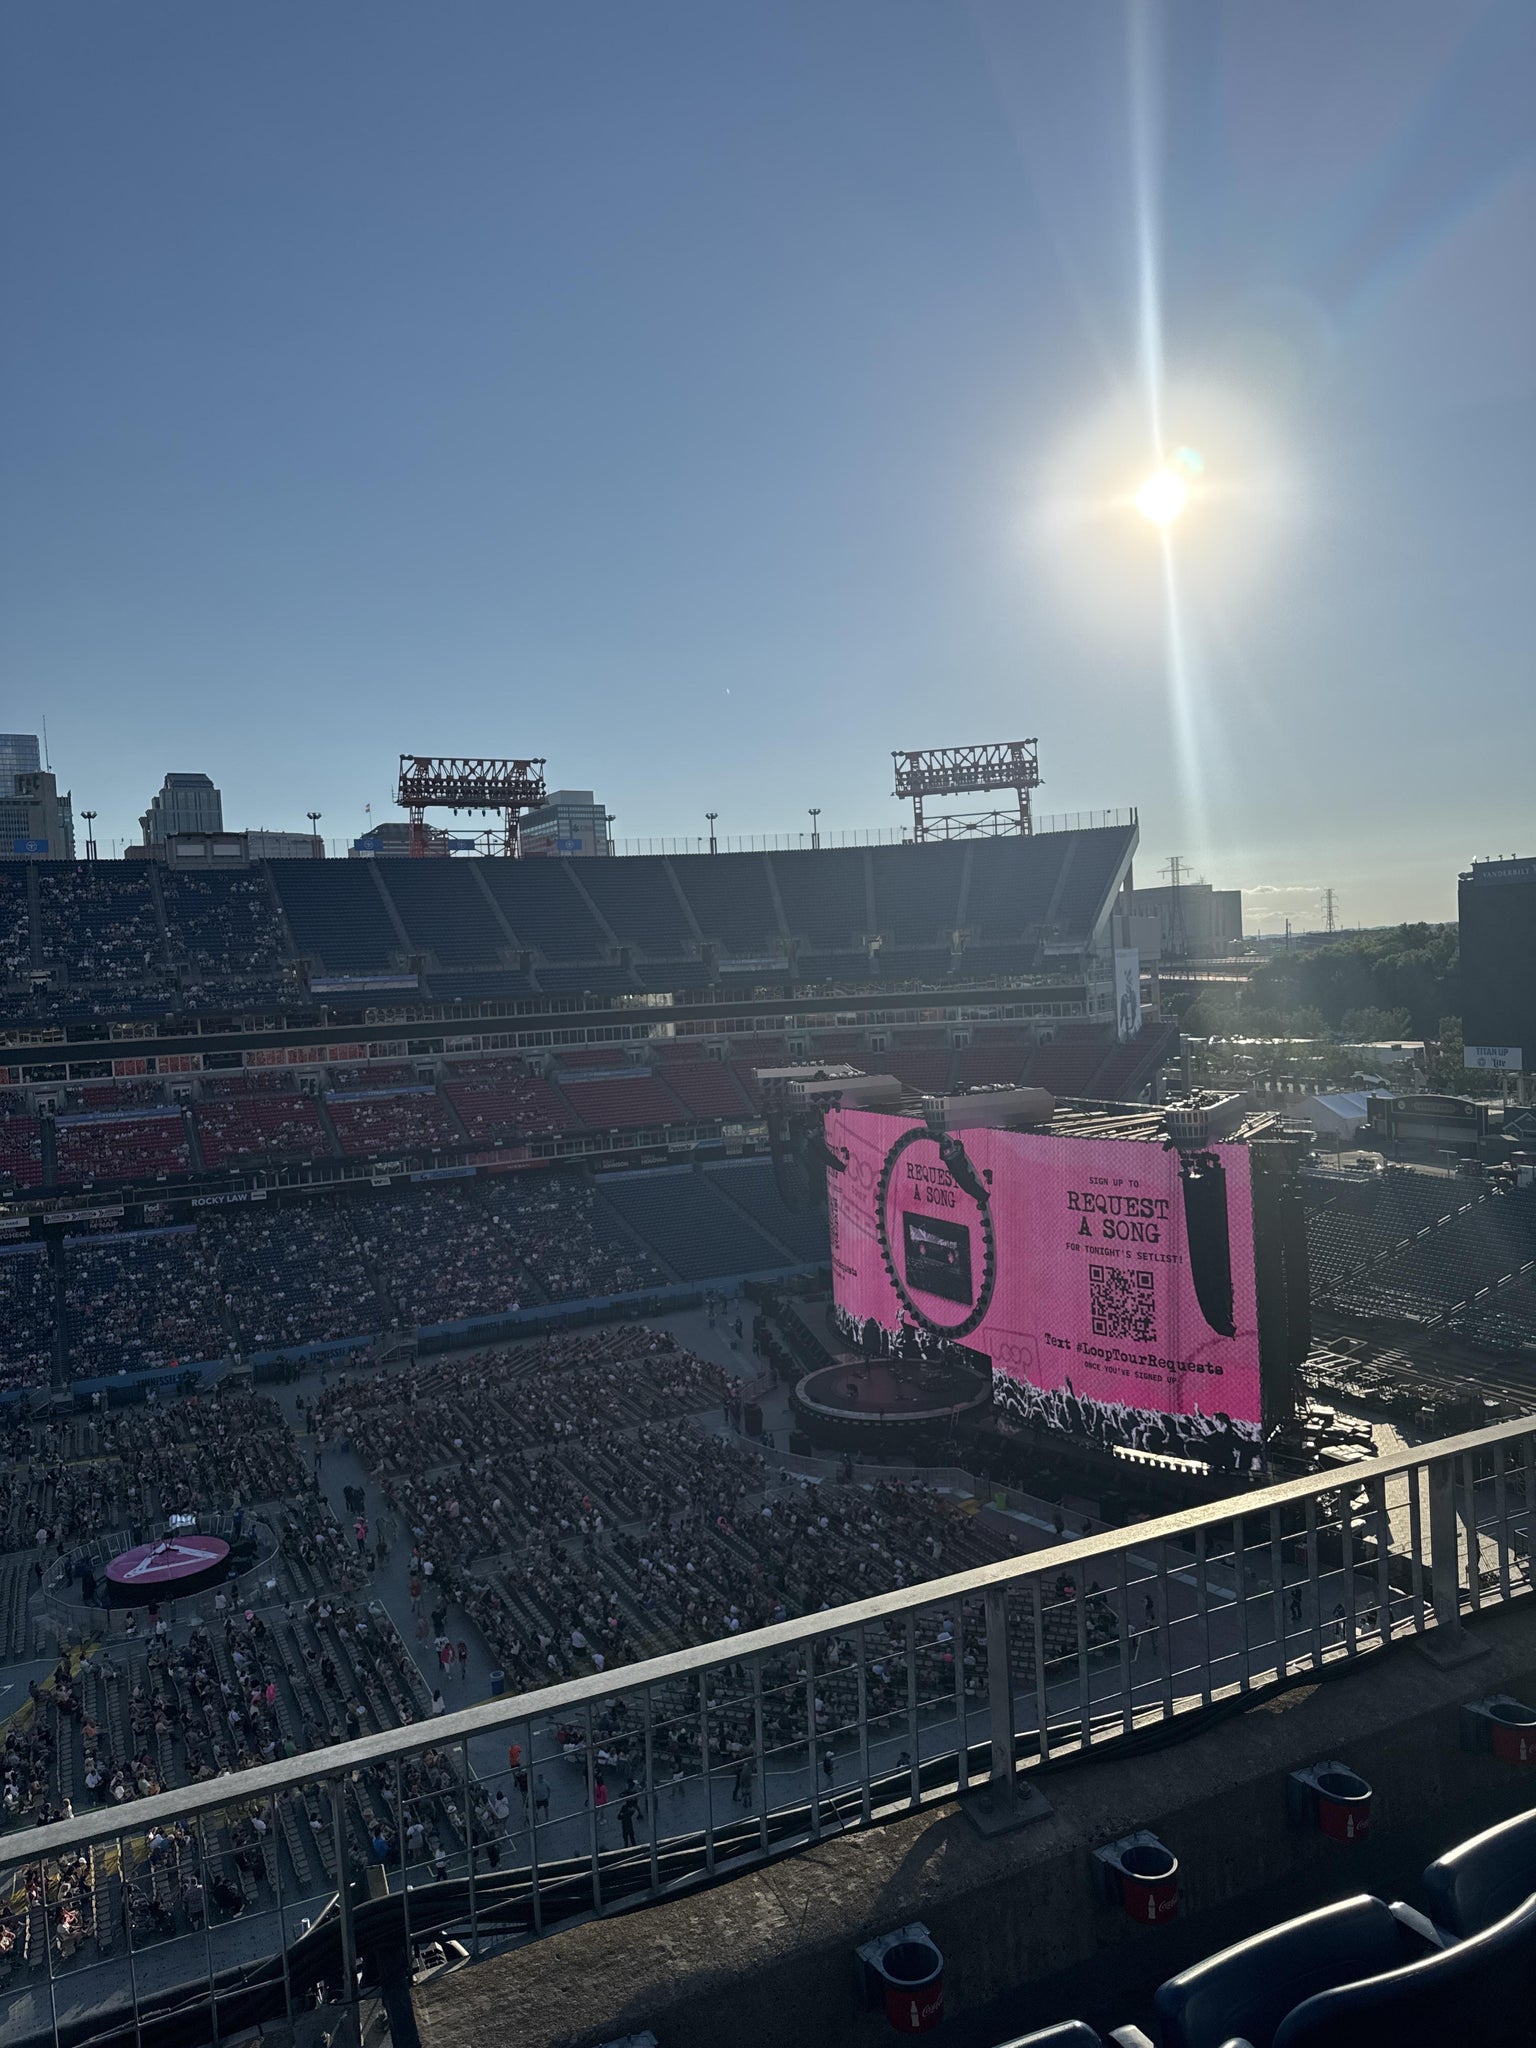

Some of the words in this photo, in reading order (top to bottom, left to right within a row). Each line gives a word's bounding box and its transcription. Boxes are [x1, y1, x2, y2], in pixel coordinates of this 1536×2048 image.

[1482, 867, 1529, 879] VANDERBILT
[1476, 1047, 1497, 1056] TITAN
[1498, 1048, 1509, 1056] UP
[1089, 1176, 1109, 1186] SIGN
[1113, 1177, 1124, 1187] UP
[1129, 1179, 1140, 1188] TO
[191, 1194, 226, 1206] ROCKY
[226, 1193, 248, 1203] LAW
[913, 1183, 922, 1201] A
[926, 1186, 956, 1208] SONG
[1066, 1190, 1170, 1220] REQUEST
[1078, 1216, 1093, 1237] A
[1102, 1218, 1161, 1244] SONG
[1065, 1242, 1080, 1252] FOR
[1085, 1245, 1132, 1259] TONIGHT'S
[1137, 1251, 1183, 1264] SETLIST!
[1044, 1332, 1072, 1350] Text
[1076, 1342, 1225, 1375] #LoopTourRequests
[1084, 1361, 1101, 1371] ONCE
[1104, 1366, 1131, 1377] YOU'VE
[1134, 1371, 1163, 1382] SIGNED
[1166, 1376, 1178, 1384] UP
